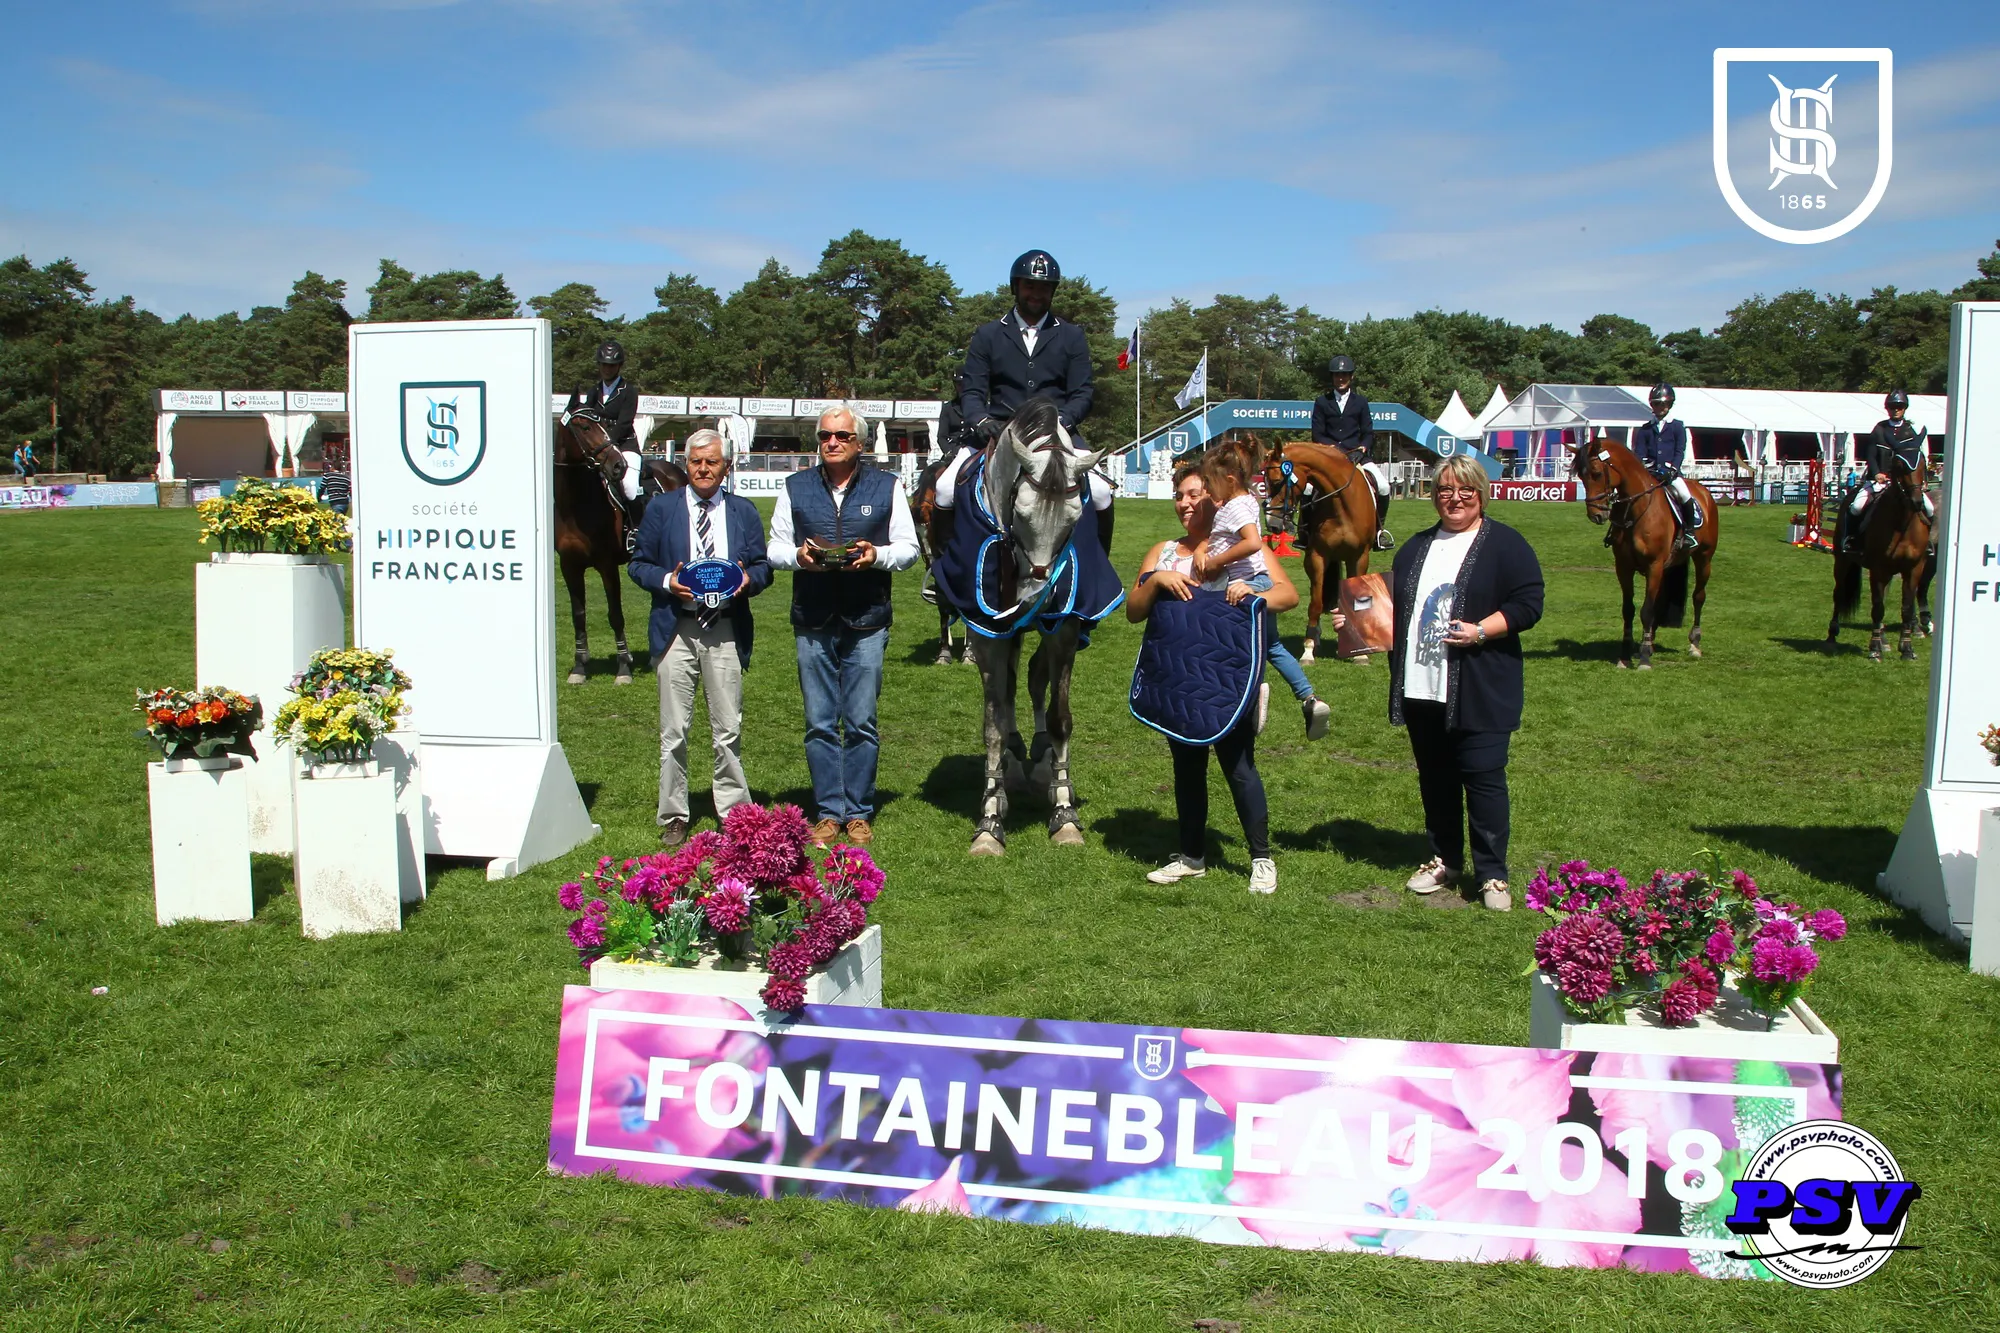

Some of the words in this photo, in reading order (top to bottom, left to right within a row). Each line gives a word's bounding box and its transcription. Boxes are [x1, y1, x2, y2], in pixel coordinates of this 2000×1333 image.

[1232, 407, 1278, 418] SOCIÉTÉ
[1283, 409, 1312, 419] HIPPI
[1370, 412, 1397, 421] ÇAISE
[432, 460, 455, 468] 1865
[740, 479, 783, 490] SELLE
[1507, 483, 1567, 502] m@rket
[412, 501, 478, 515] société
[378, 528, 516, 550] HIPPIQUE
[372, 561, 523, 584] FRANÇAISE
[643, 1056, 1435, 1186] FONTAINEBLEAU
[1475, 1118, 1723, 1204] 2018
